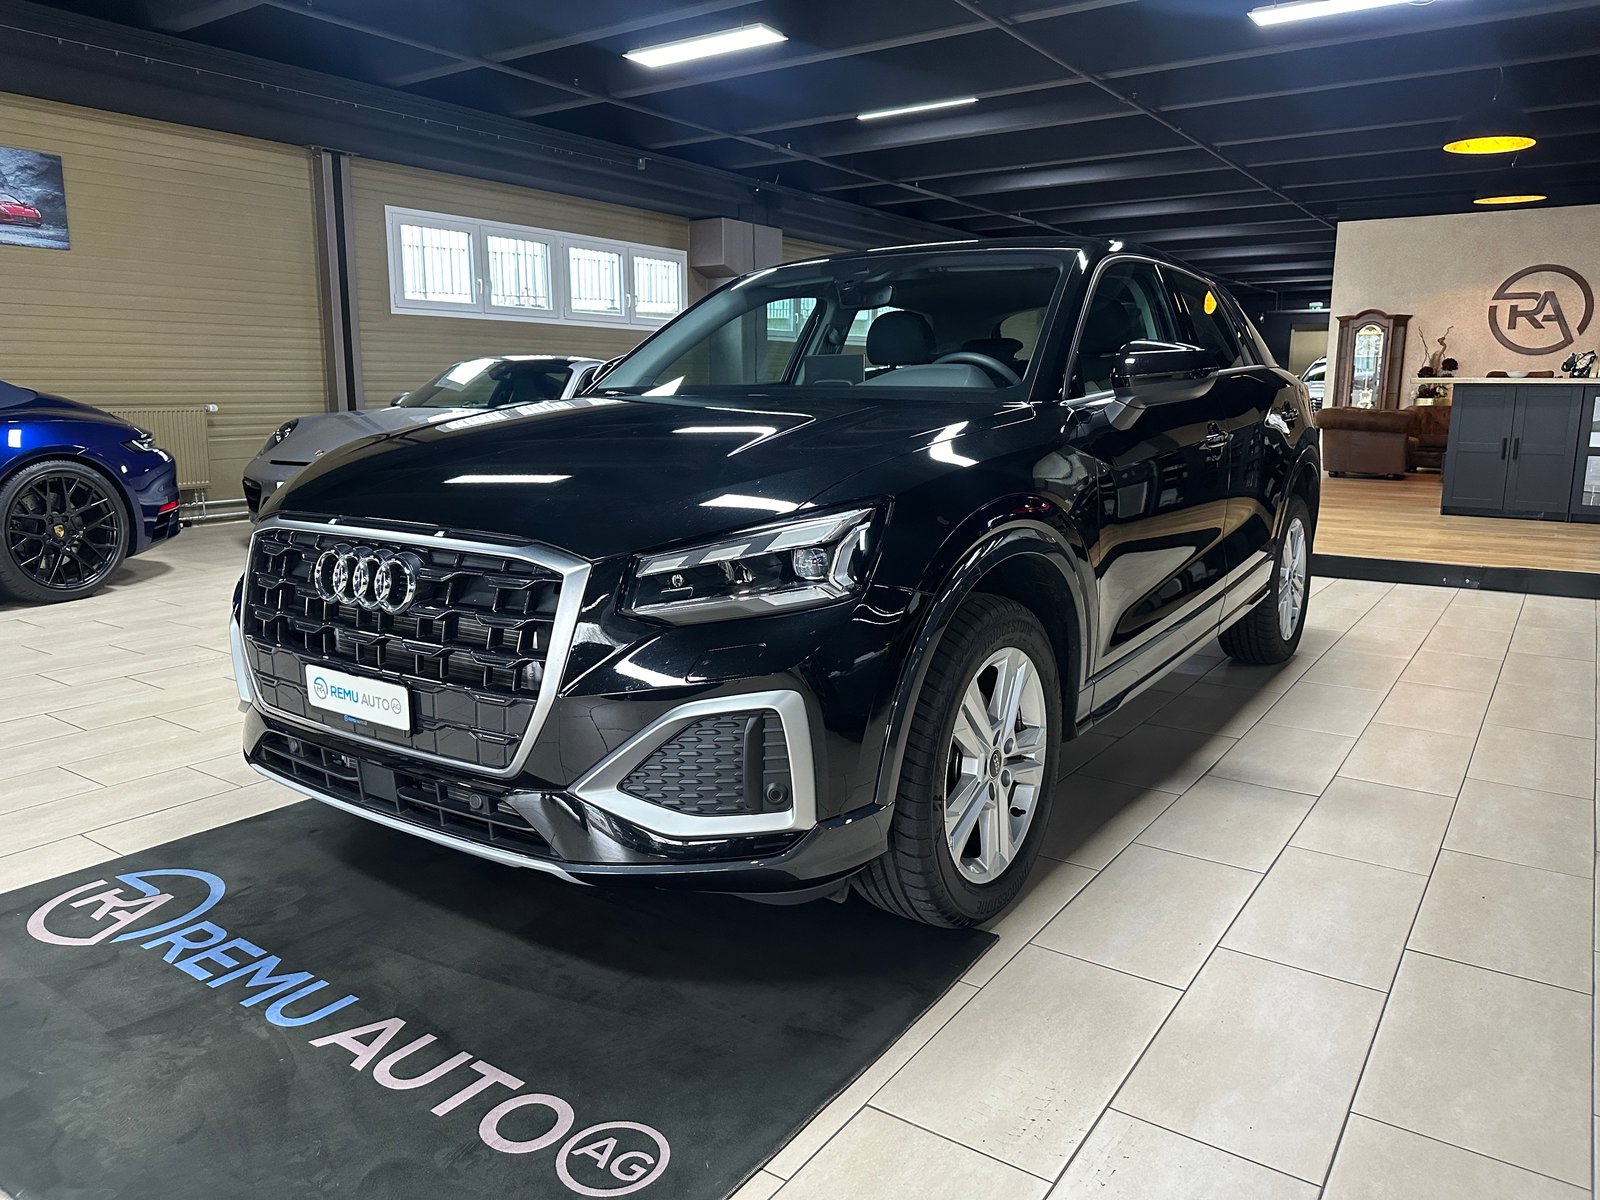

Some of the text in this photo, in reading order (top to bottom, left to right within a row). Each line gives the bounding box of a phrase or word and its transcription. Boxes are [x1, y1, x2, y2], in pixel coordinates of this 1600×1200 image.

[330, 685, 359, 703] REMU
[361, 693, 390, 711] AUTO
[141, 921, 359, 1027] REMU
[308, 1017, 575, 1154] AUTO
[570, 1134, 657, 1184] AG
